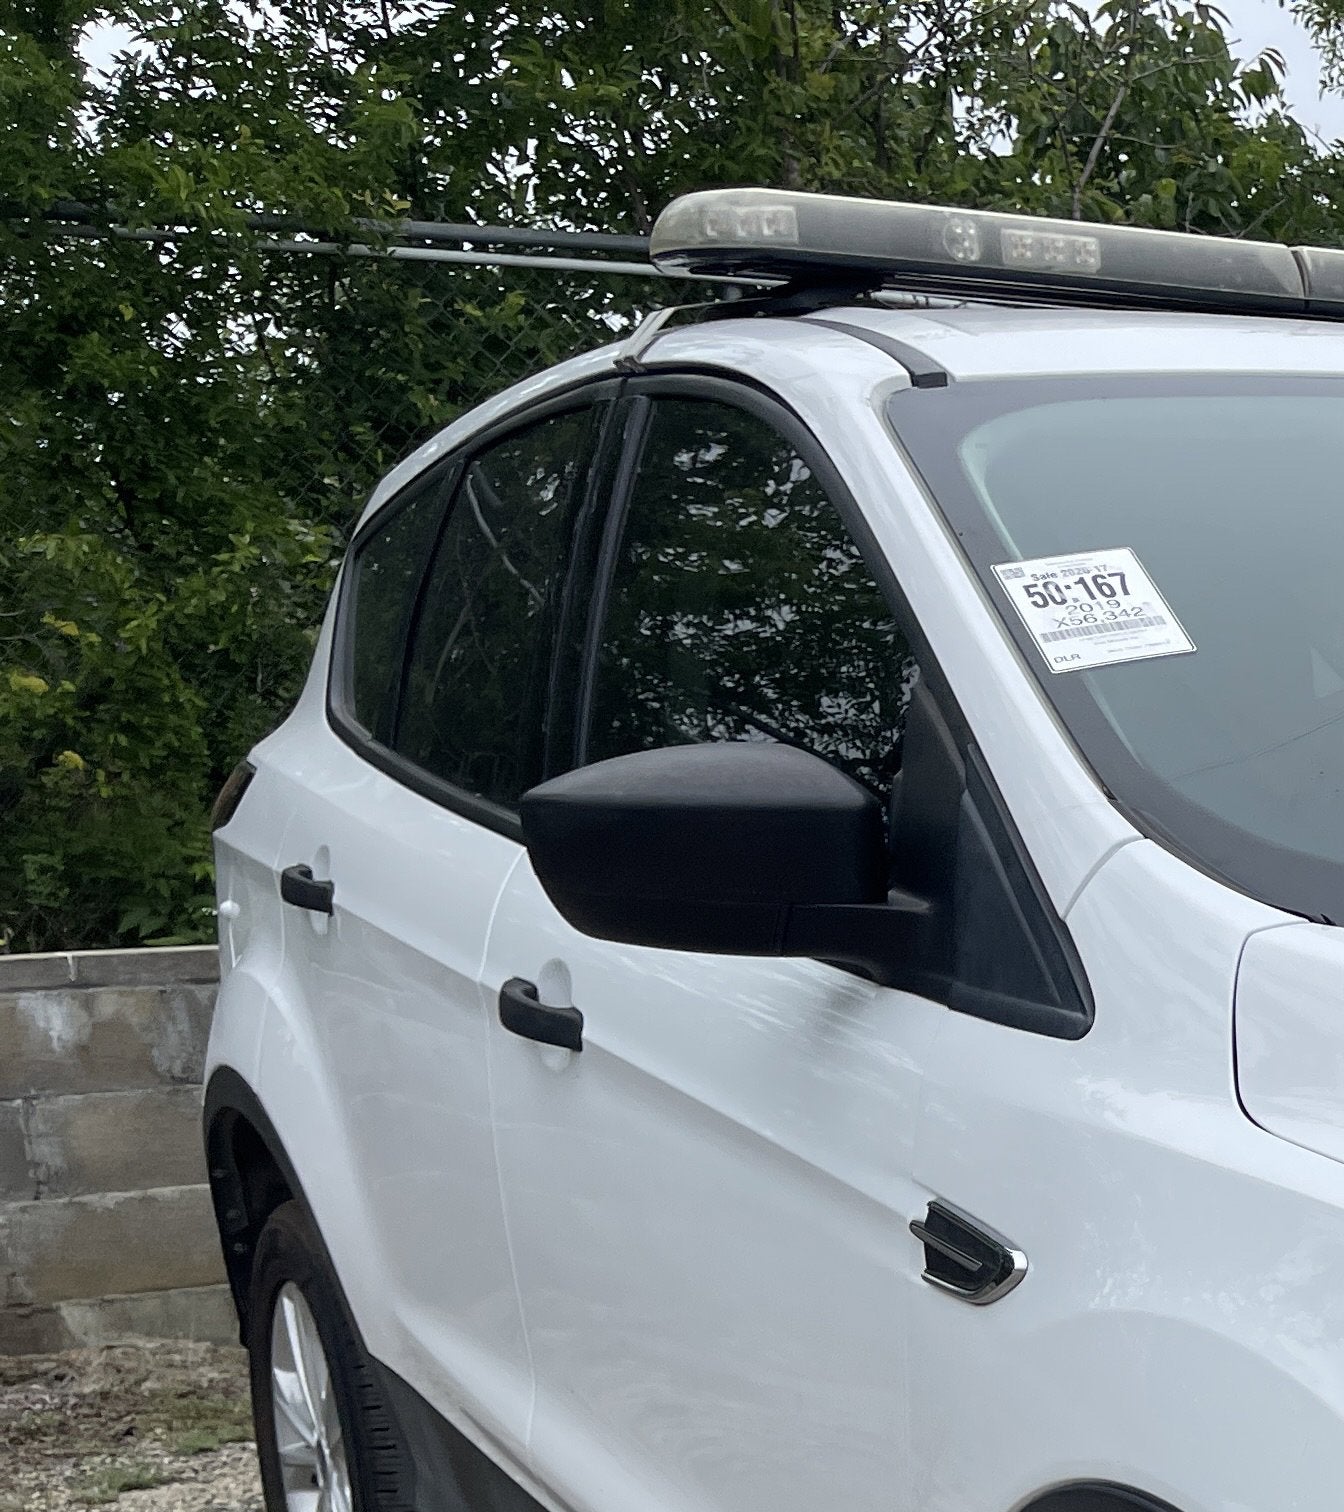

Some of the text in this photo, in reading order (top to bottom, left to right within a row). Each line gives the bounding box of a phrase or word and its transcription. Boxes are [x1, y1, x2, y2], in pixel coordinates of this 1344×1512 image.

[1030, 571, 1058, 581] Sale
[1023, 571, 1131, 608] 50:167
[1065, 599, 1121, 615] 2019
[1054, 653, 1081, 663] DLR
